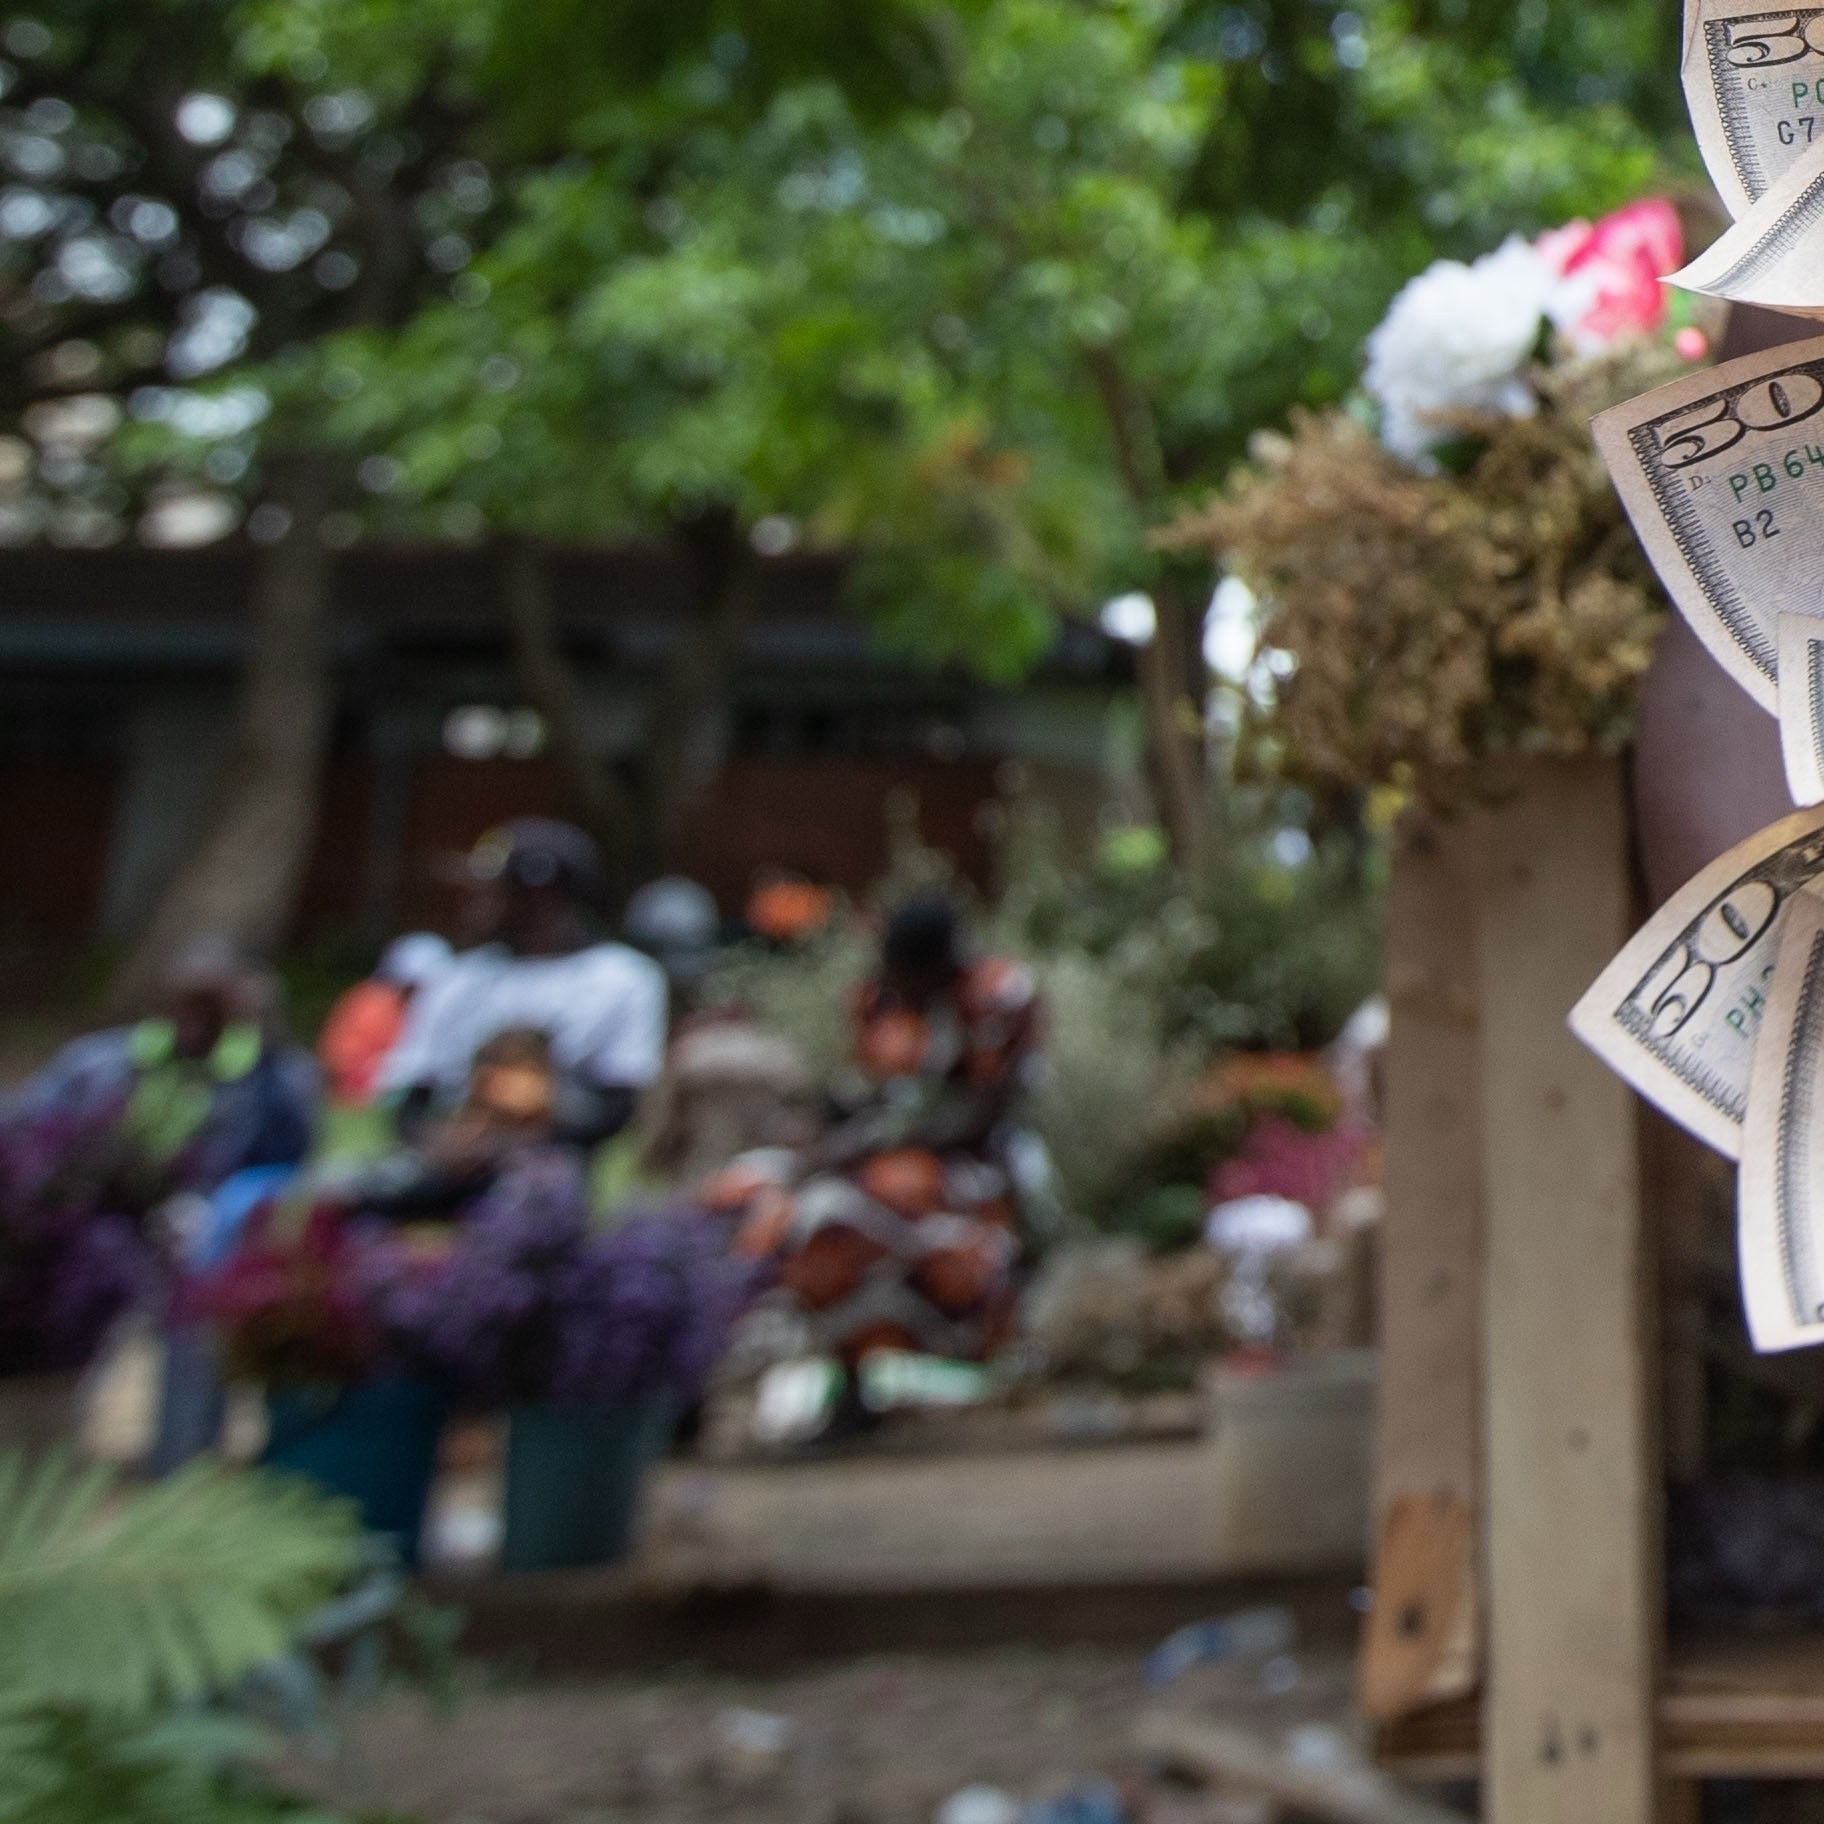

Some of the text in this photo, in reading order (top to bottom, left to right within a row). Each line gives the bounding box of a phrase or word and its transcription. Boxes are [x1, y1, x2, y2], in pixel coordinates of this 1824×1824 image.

[1777, 117, 1815, 145] G7
[1729, 462, 1777, 503] PB
[1732, 509, 1780, 549] B2
[1652, 879, 1779, 1037] 50
